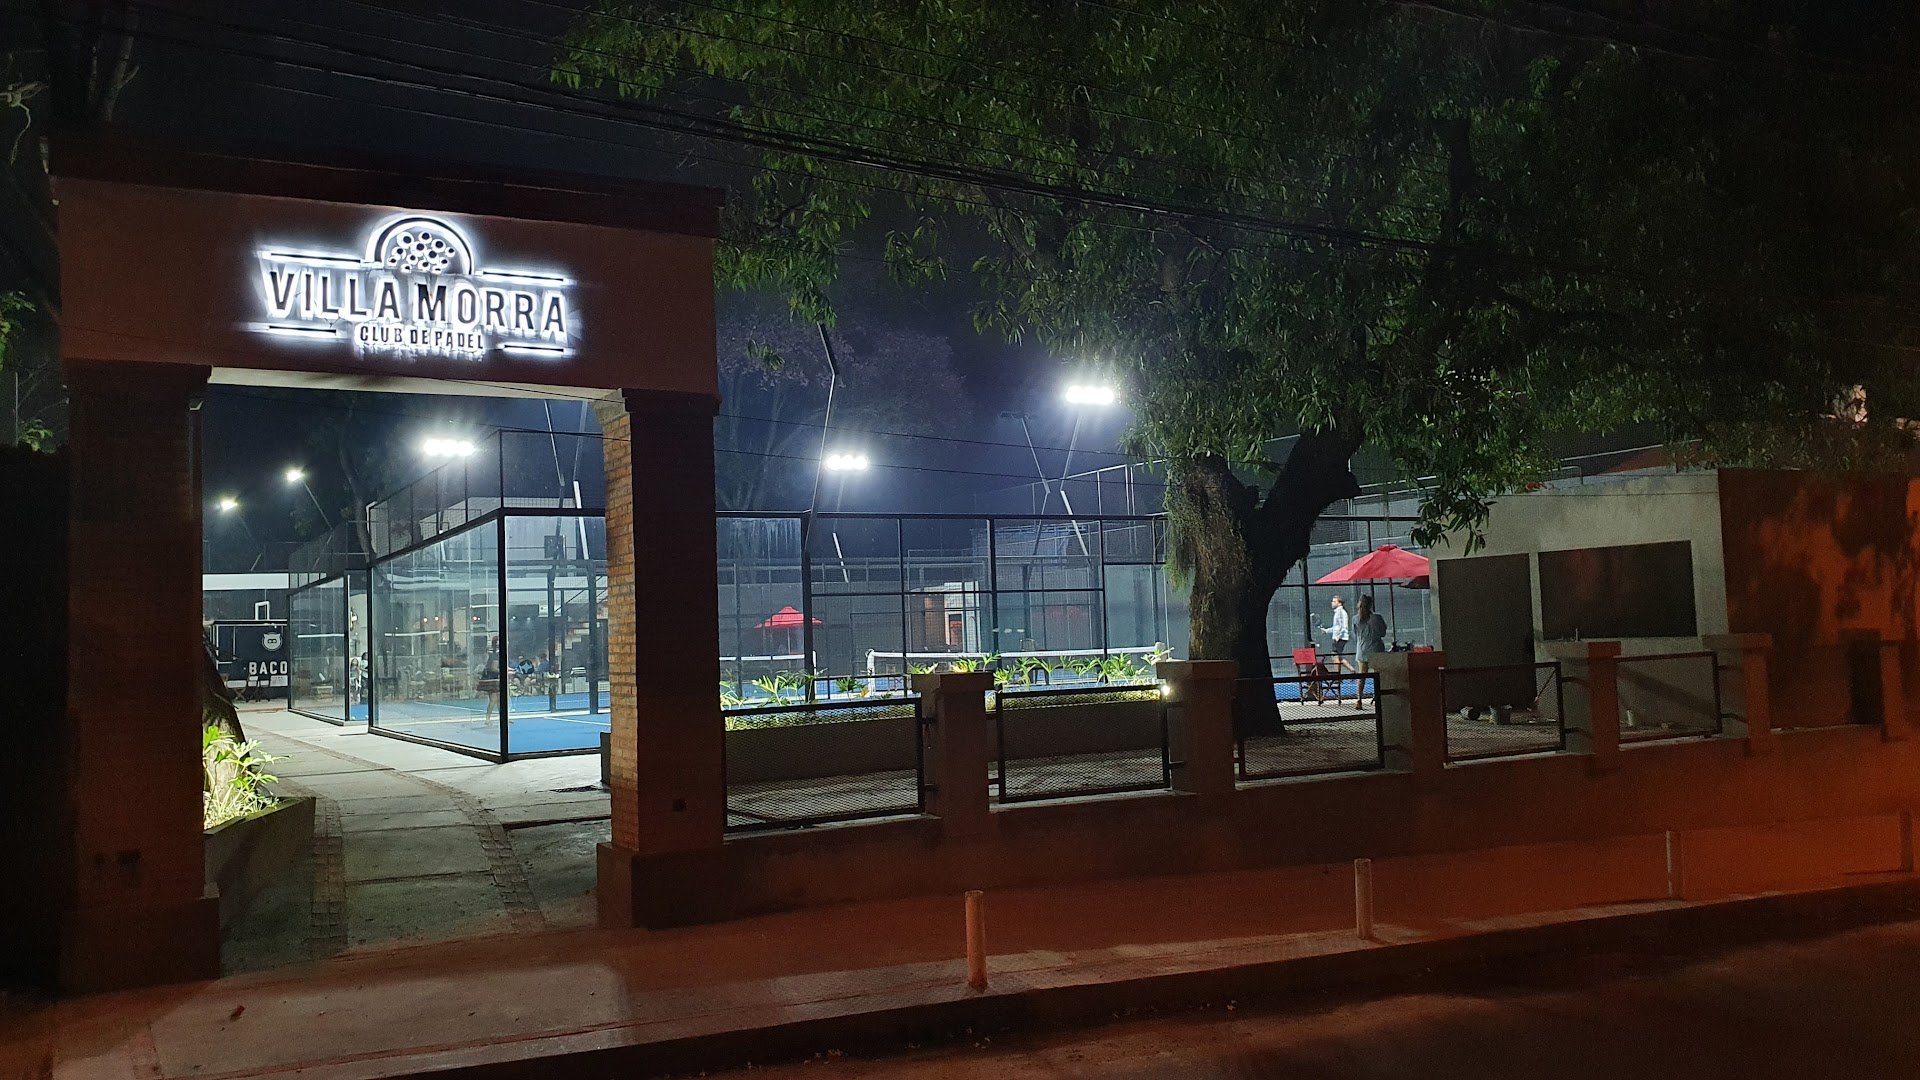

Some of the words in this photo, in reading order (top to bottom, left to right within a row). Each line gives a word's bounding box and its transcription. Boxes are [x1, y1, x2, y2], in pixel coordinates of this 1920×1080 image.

[269, 271, 400, 320] VILLA
[417, 283, 565, 333] MORRA
[360, 325, 403, 343] CLUB
[410, 329, 429, 345] DE
[435, 331, 484, 350] PADEL
[249, 661, 288, 675] BACO
